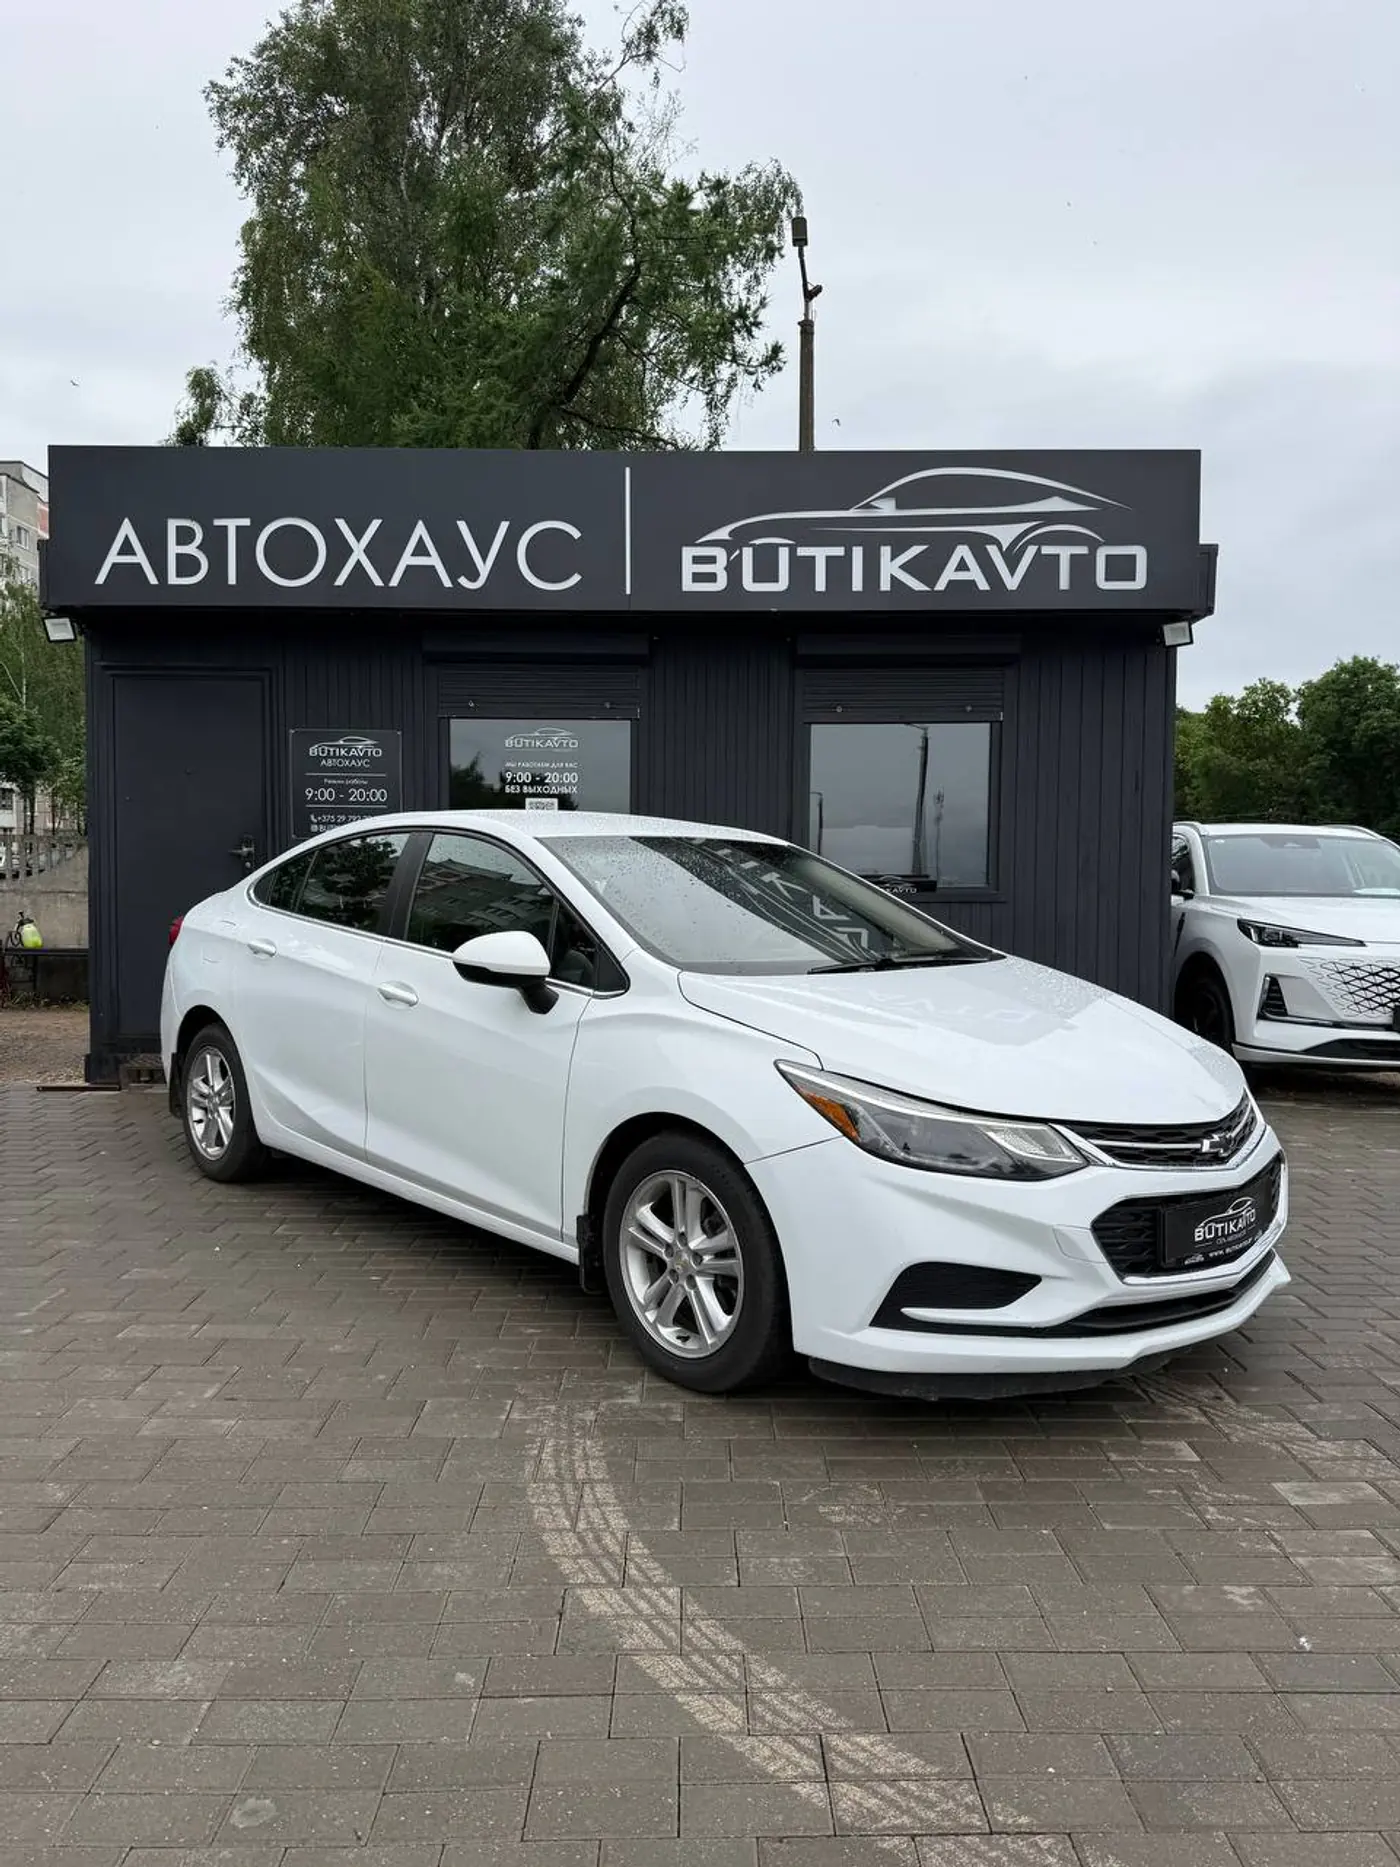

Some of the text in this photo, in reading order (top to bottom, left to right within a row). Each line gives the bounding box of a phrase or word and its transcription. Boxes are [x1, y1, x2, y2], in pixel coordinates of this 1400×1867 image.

[95, 517, 583, 590] АВТОХАУС
[681, 544, 1147, 592] BUTIKAVTO
[505, 739, 578, 748] BUTIKAVTO
[309, 747, 382, 757] BUTIKAVTO
[320, 759, 371, 768] АВТОХАУС
[506, 772, 532, 783] 9:00
[544, 772, 579, 783] 20:00
[505, 785, 520, 793] БЕЗ
[305, 788, 335, 800] 9:00
[348, 788, 388, 802] 20:00
